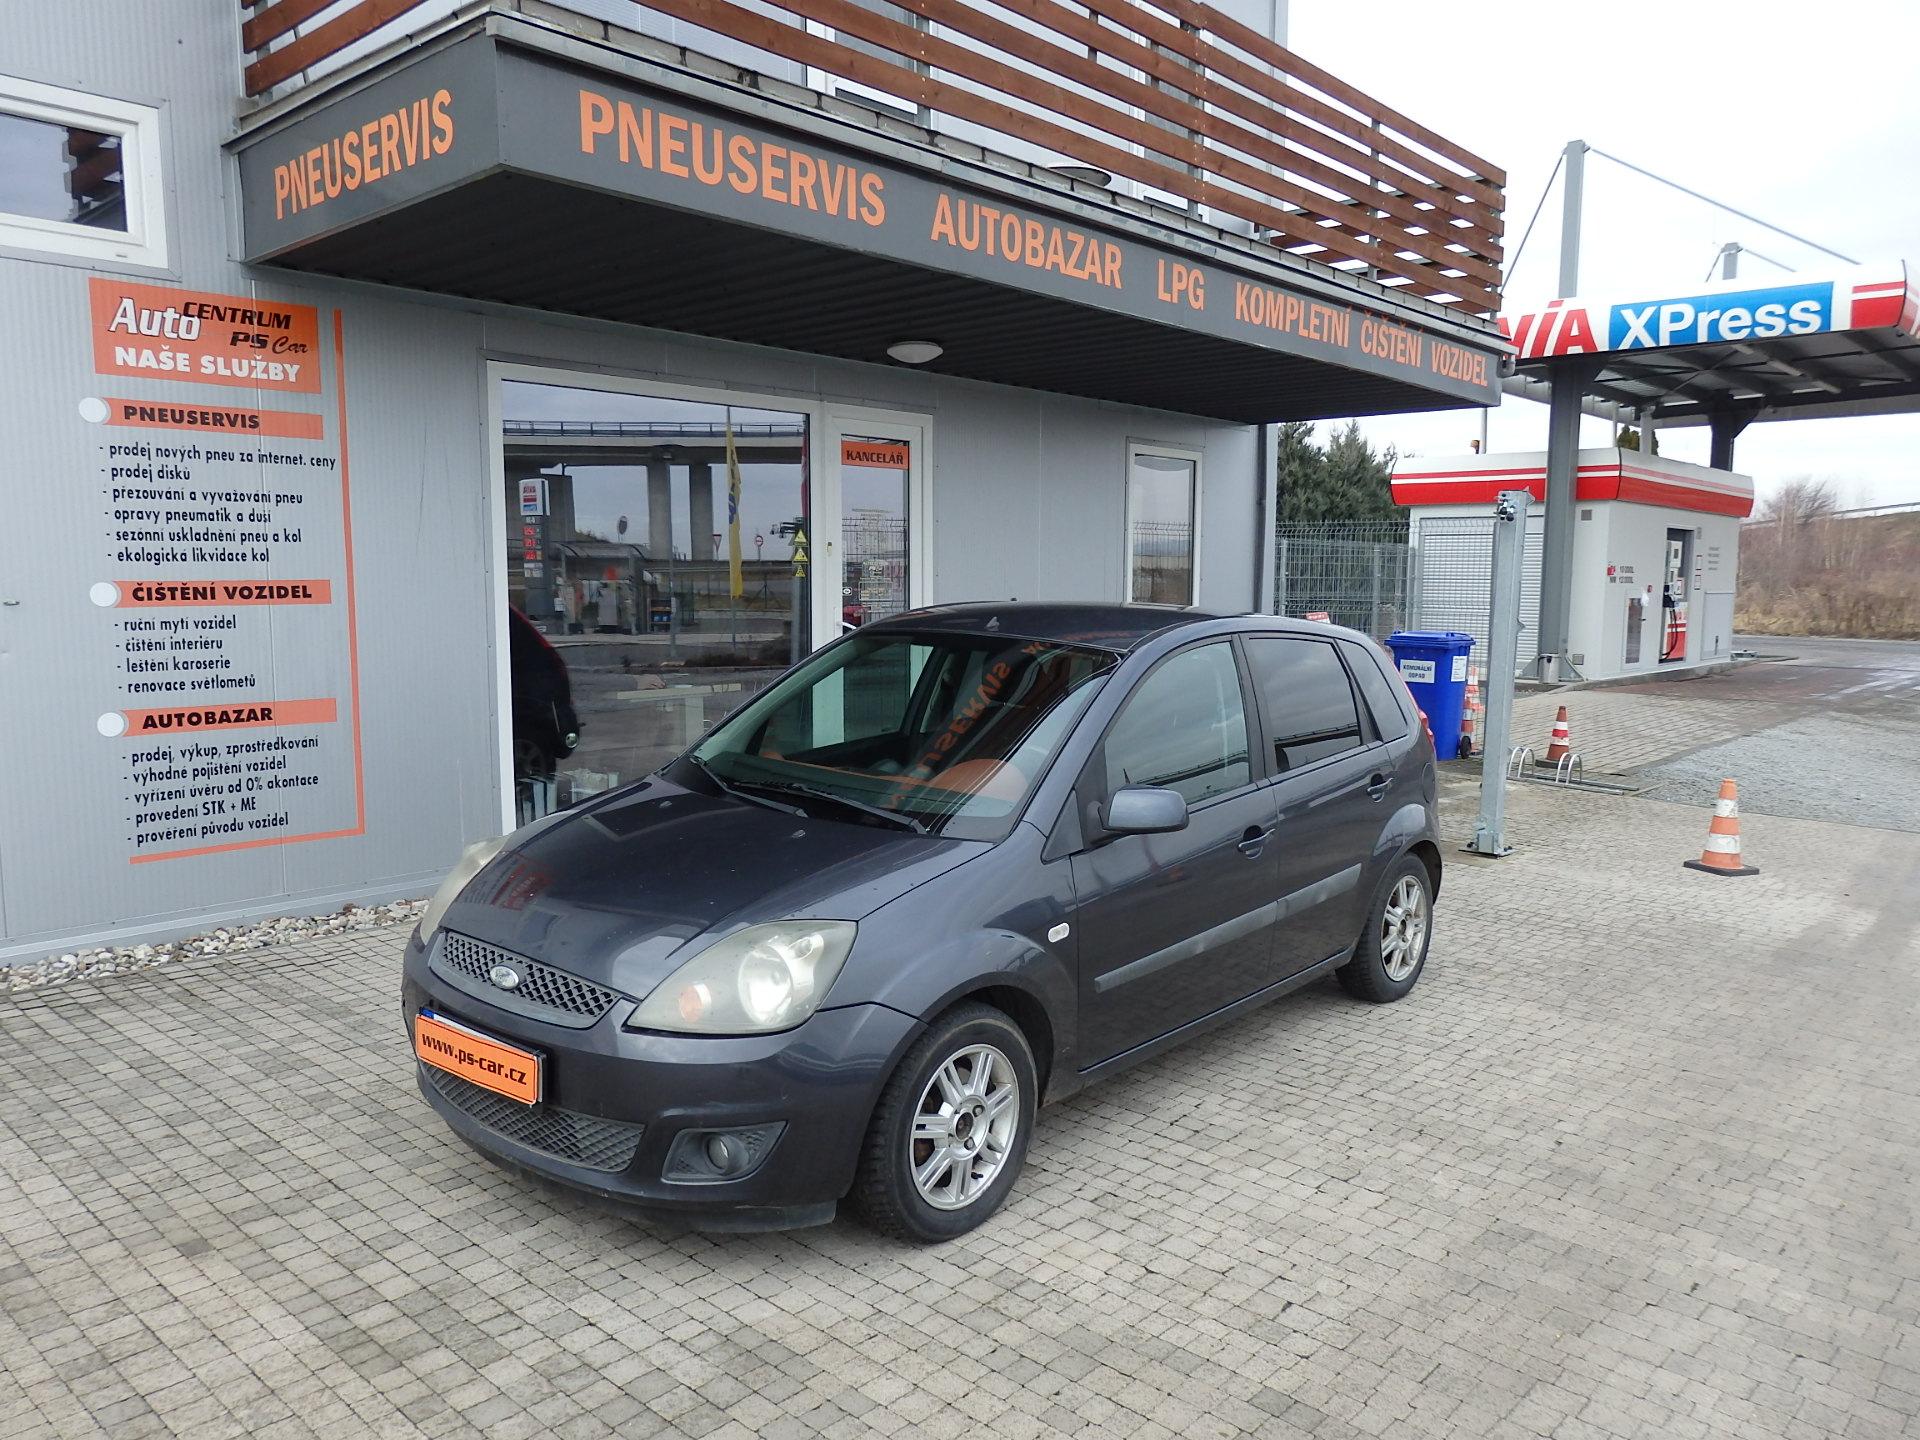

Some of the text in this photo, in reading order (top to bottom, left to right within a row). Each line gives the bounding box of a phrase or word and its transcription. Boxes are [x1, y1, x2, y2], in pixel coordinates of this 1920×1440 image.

[273, 88, 455, 221] PNEUSERVIS
[578, 89, 1488, 387] PNEUSERVIS AUTOBAZAR LPG KOMPLETNÍ ČIŠTĚNÍ VOZIDEL
[108, 296, 292, 341] Auto CENTRUM
[1497, 299, 1823, 360] VIA XPress
[230, 331, 308, 354] PS Car
[115, 344, 300, 383] NAŠE SLUŽBY
[124, 405, 260, 429] PNEUSERVIS
[110, 441, 336, 471] prodej nových pneu za internet. ceny
[846, 450, 904, 465] KANCELÁŘ
[111, 463, 191, 483] prodej disků
[113, 485, 303, 507] přezouvání a vyvažování pneu
[114, 506, 272, 524] opravy pneumatik a duší
[116, 526, 302, 545] sezónní uskladnění pneu a kol
[117, 546, 269, 566] ekologická likvidace kol
[132, 582, 312, 602] ČIŠTĚNÍ VOZIDEL
[124, 614, 236, 634] ruční mytí vozidel
[125, 635, 223, 652] čištění interiéru
[126, 654, 231, 672] leštění karoserie
[127, 673, 256, 693] renovace světlometů
[142, 707, 274, 730] AUTOBAZAR
[132, 735, 319, 767] prodej, výkup, zprostředkování
[133, 755, 286, 787] výhodné pojištění vozidel
[134, 774, 319, 807] vyřízení úvěru od 0% akontace
[136, 803, 198, 828] provedení
[202, 800, 226, 816] STK
[240, 796, 257, 811] ME
[136, 811, 289, 848] prověření původu vozidel
[421, 1033, 527, 1086] www.ps-car.cz
